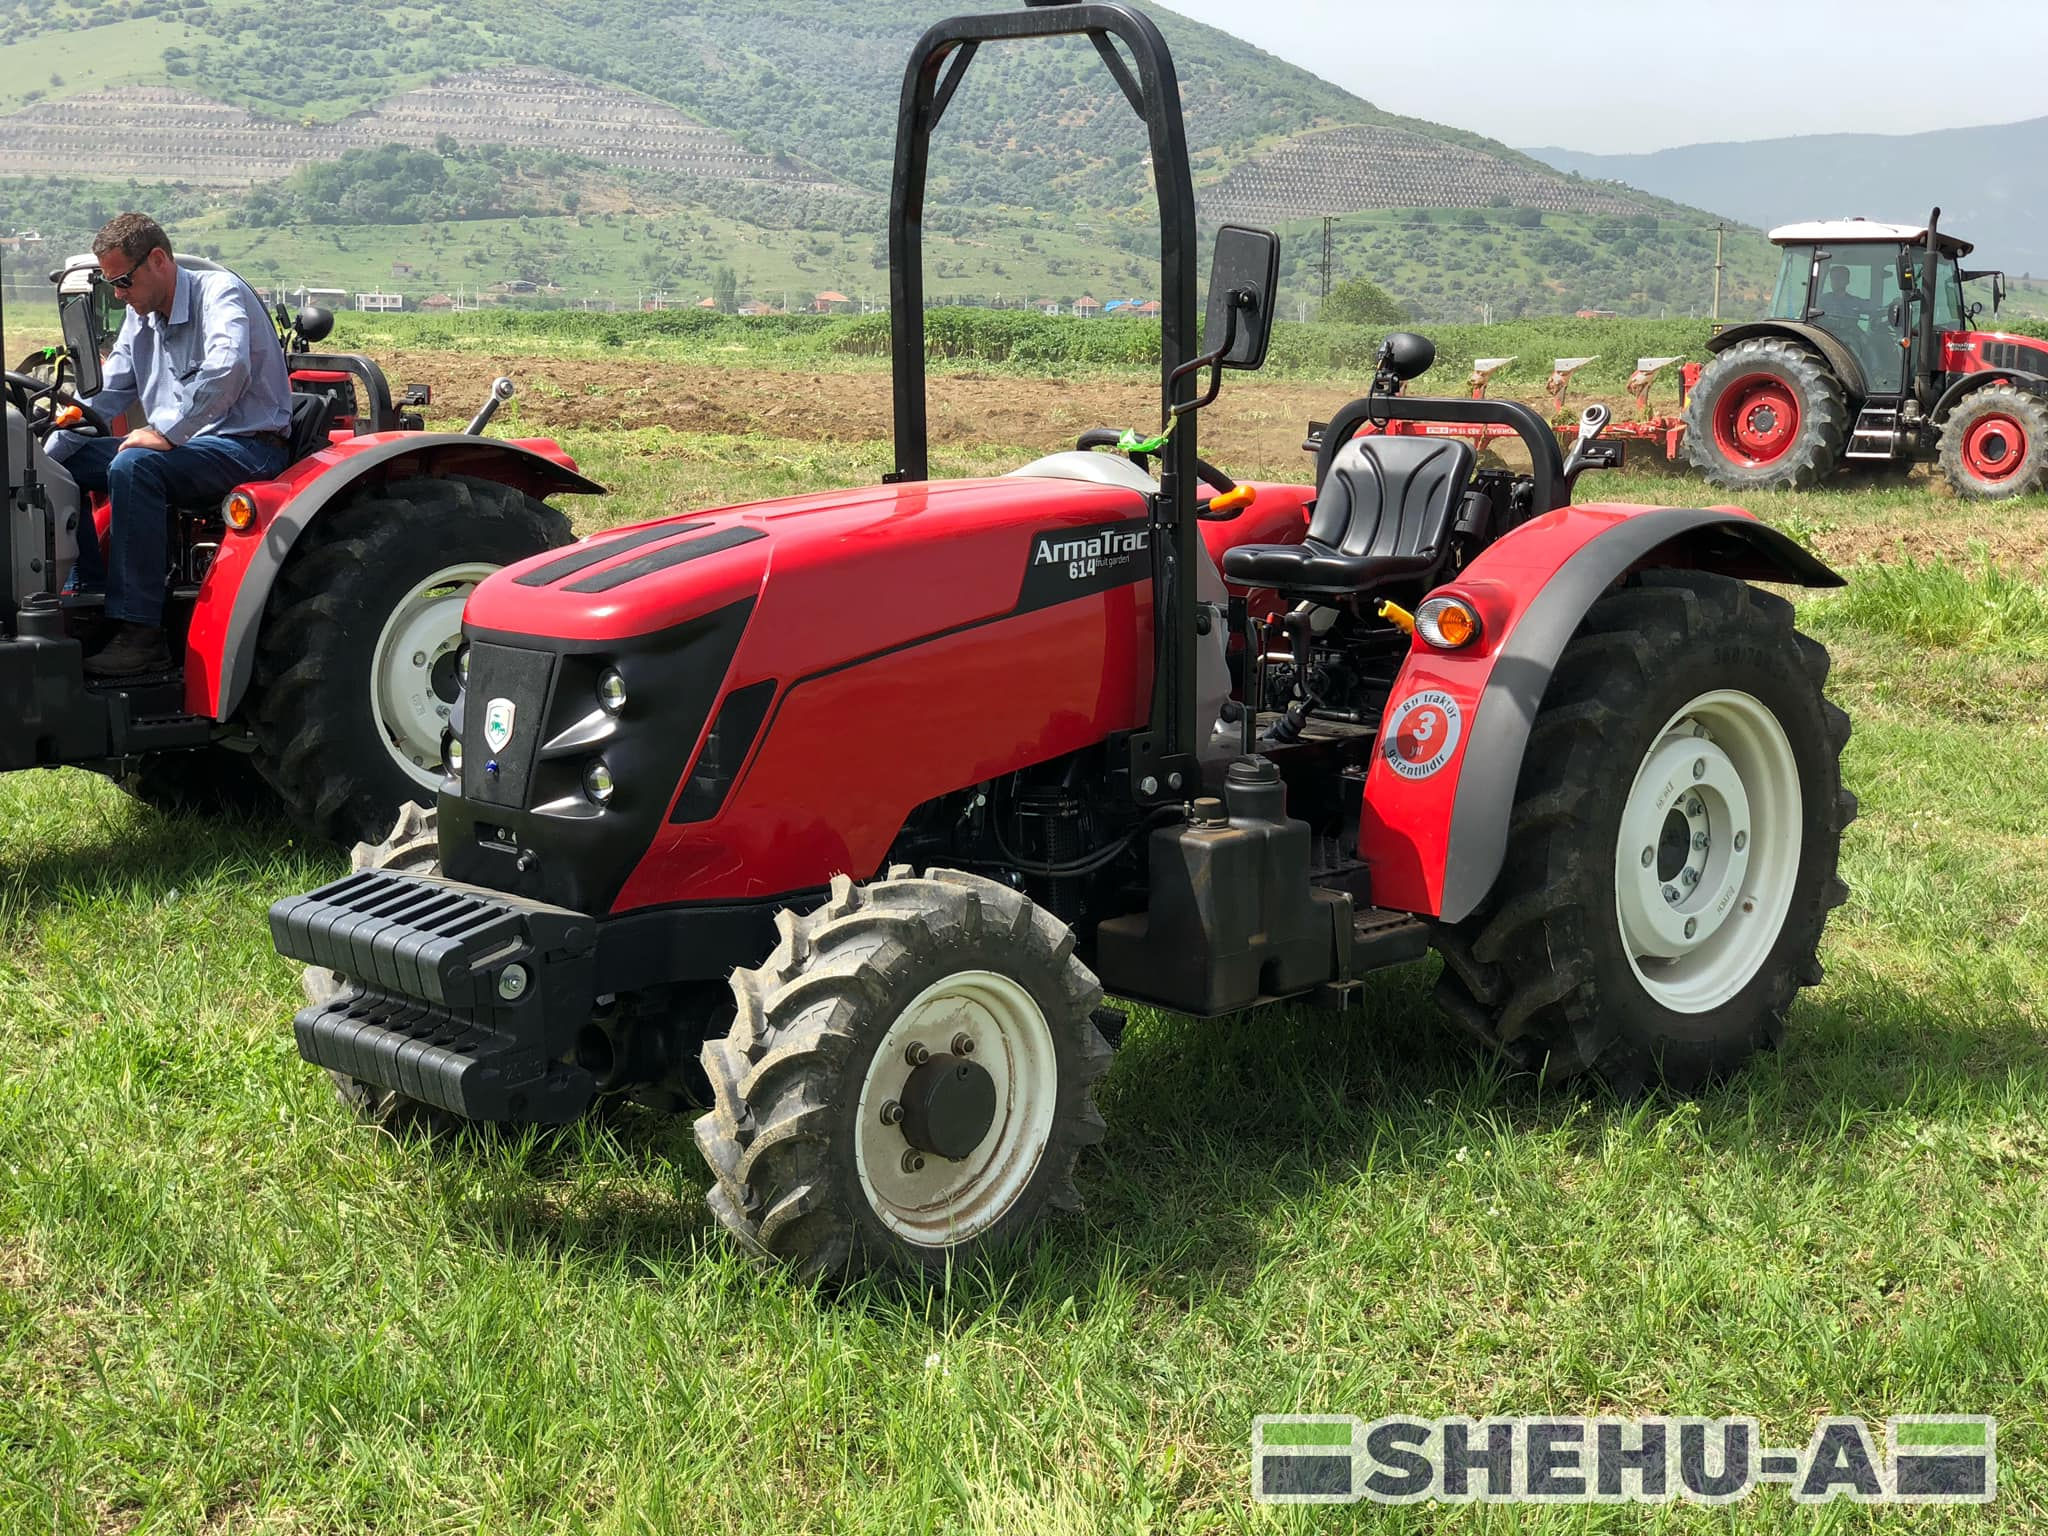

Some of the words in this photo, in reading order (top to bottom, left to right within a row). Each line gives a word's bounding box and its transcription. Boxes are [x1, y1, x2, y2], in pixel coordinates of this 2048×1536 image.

[1034, 531, 1149, 566] ArmaTrac
[1069, 558, 1096, 580] 614
[1096, 556, 1108, 568] fruit
[1108, 554, 1130, 568] garden
[1402, 698, 1419, 713] Bu
[1424, 694, 1457, 719] traktör
[1412, 711, 1437, 740] 3
[1387, 748, 1445, 776] garantilidir
